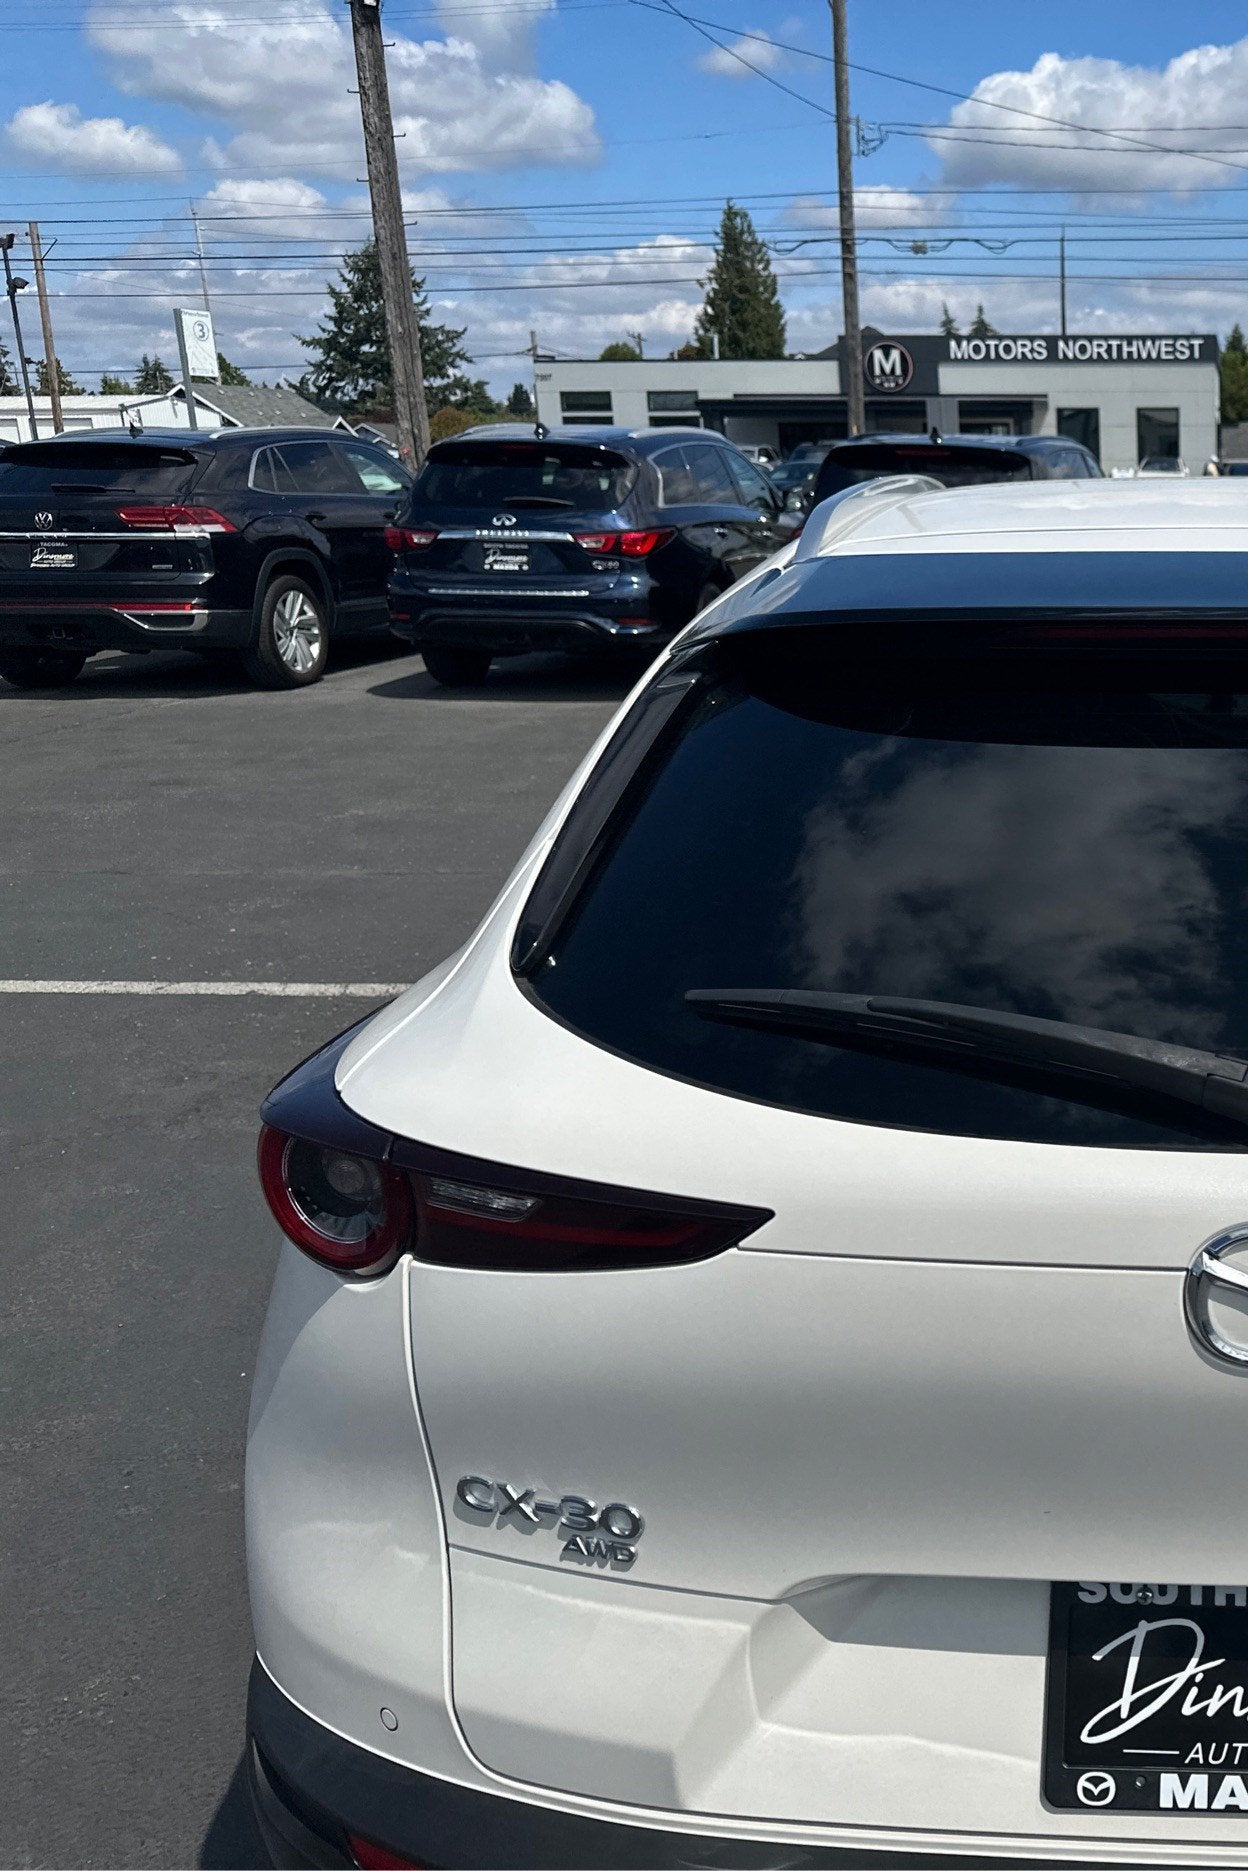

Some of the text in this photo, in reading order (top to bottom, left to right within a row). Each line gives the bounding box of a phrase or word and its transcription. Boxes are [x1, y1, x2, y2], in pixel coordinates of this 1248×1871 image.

[872, 347, 903, 377] M
[950, 338, 1205, 361] MOTORS NORTHWEST
[456, 1475, 643, 1540] CX-30
[562, 1534, 638, 1563] AWD
